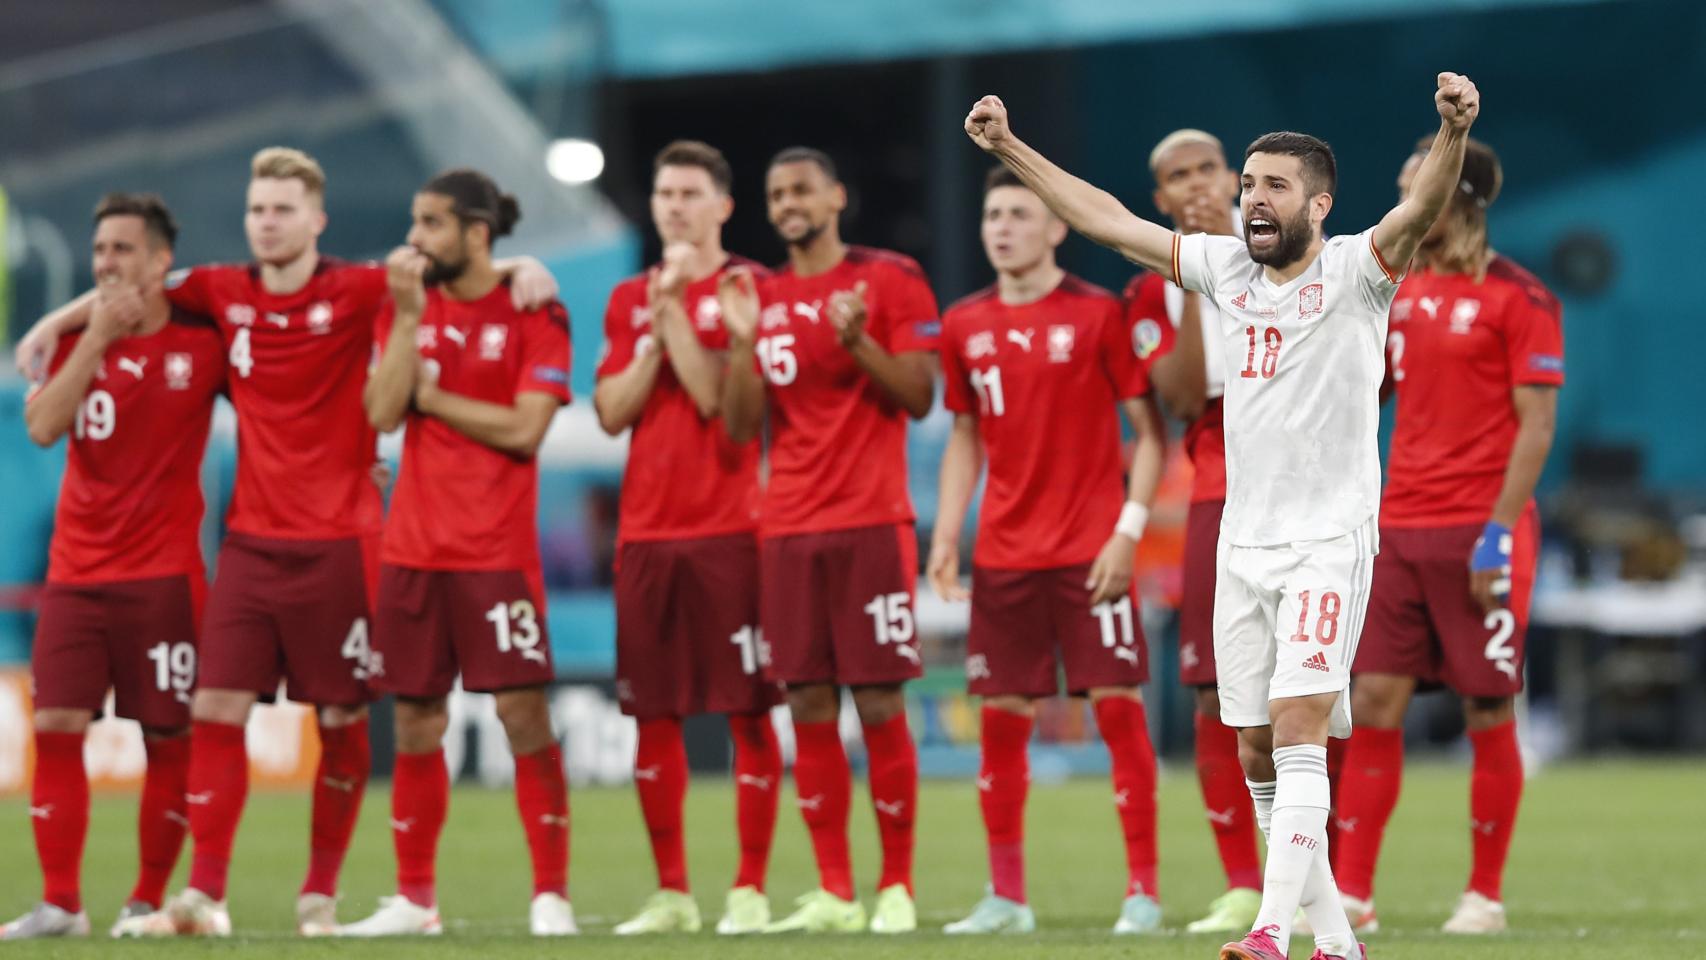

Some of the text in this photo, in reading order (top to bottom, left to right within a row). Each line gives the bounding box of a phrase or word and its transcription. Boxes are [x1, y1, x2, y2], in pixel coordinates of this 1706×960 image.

[228, 327, 255, 379] 4
[756, 334, 798, 386] 15
[1240, 325, 1282, 379] 18
[970, 365, 1005, 416] 11
[341, 617, 369, 668] 4
[485, 600, 540, 652] 13
[864, 591, 914, 645] 15
[1090, 596, 1134, 647] 11
[1290, 590, 1341, 645] 18
[1484, 608, 1515, 660] 2
[147, 641, 196, 691] 19
[1302, 661, 1330, 672] adidas
[1291, 833, 1319, 851] RFEF
